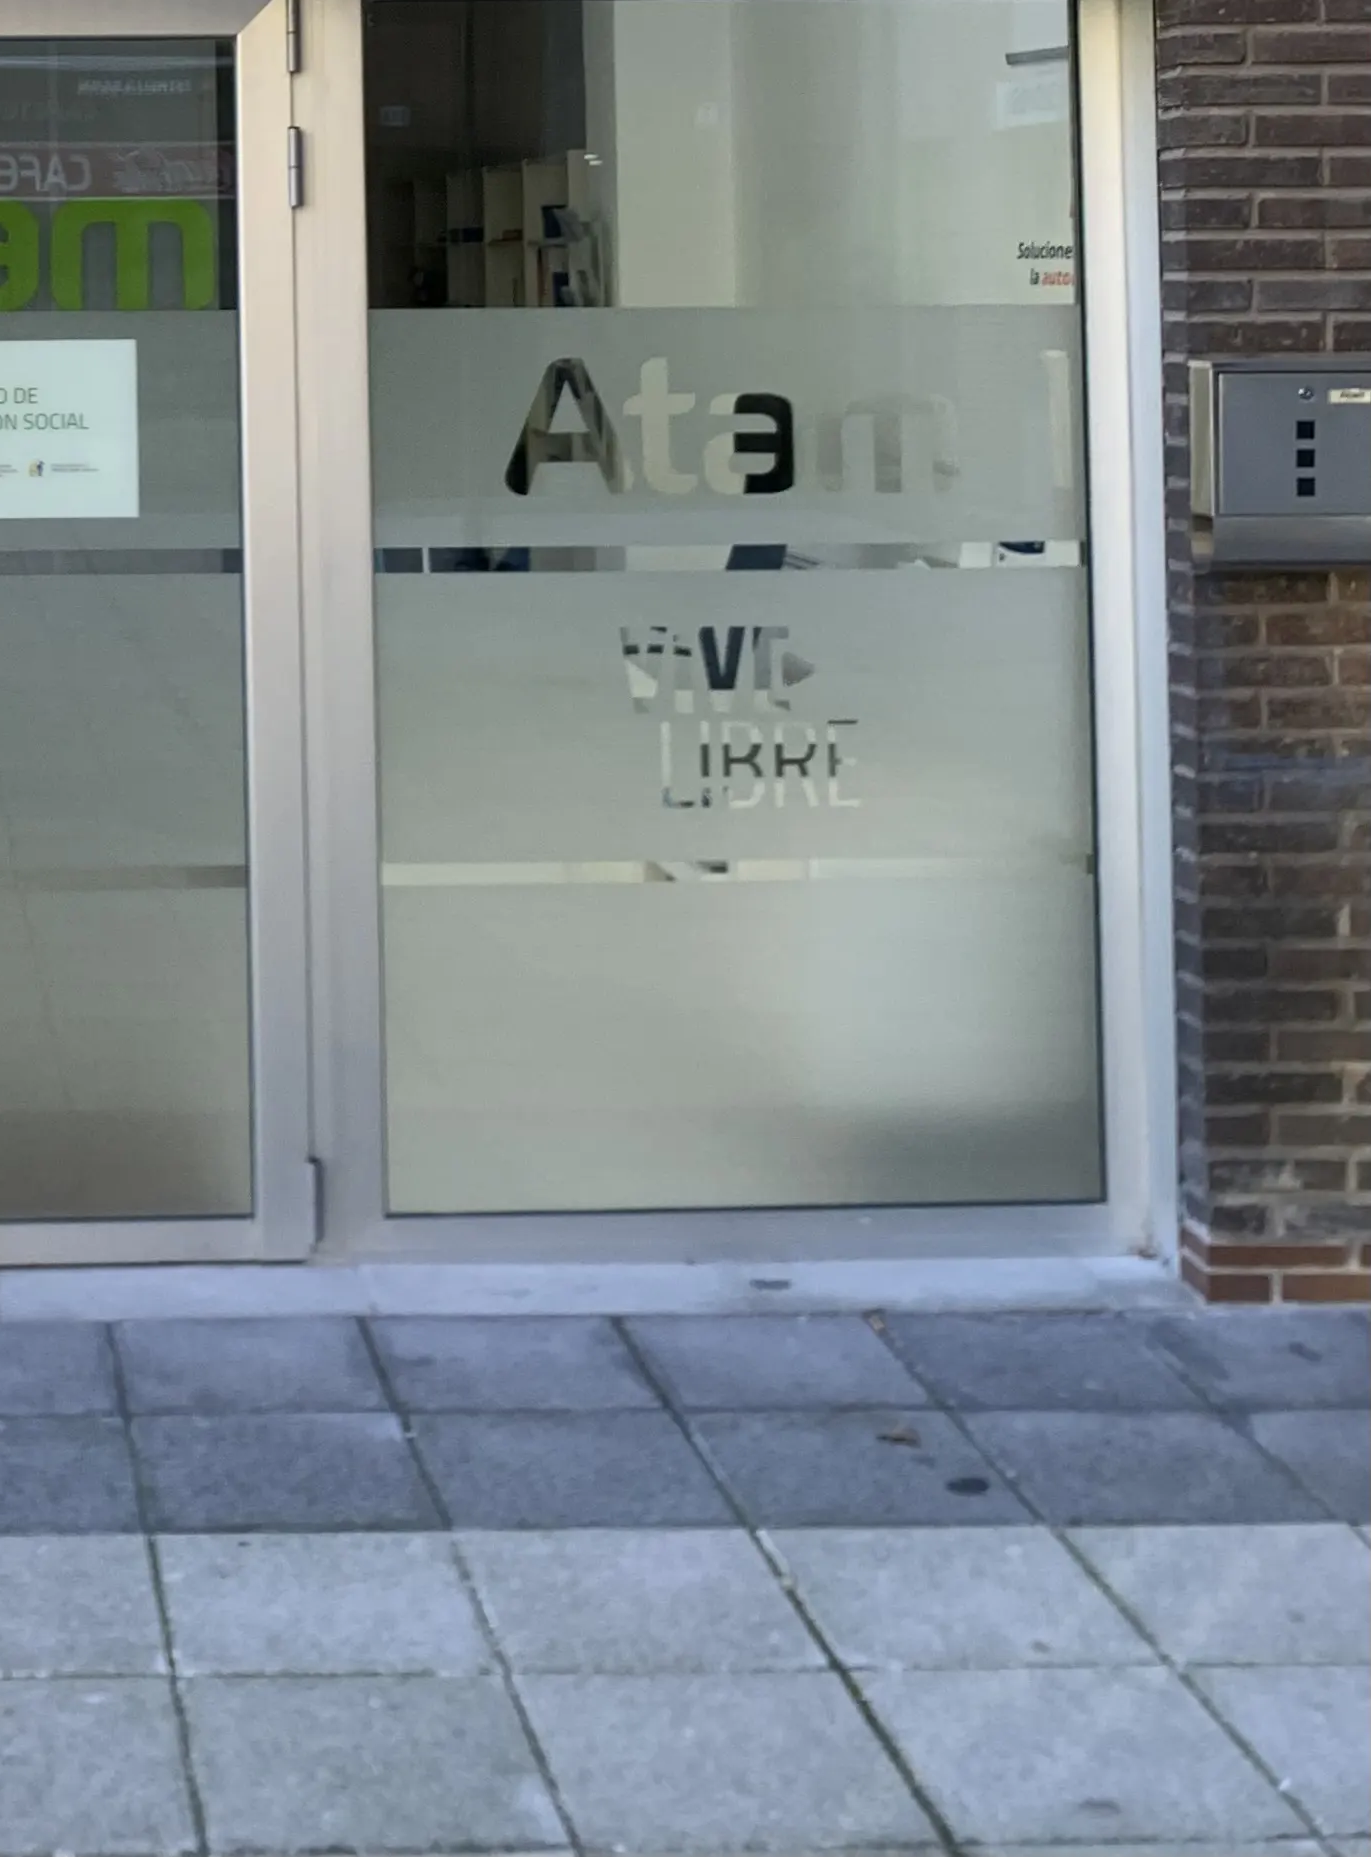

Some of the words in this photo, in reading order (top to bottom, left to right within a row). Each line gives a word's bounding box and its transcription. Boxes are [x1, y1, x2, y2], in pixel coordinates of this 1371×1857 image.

[1016, 240, 1074, 259] Solucione
[13, 387, 38, 404] DE
[23, 413, 90, 430] SOCIAL
[505, 357, 960, 496] Atam
[619, 625, 790, 714] VIVE
[660, 719, 861, 809] LIBRE
